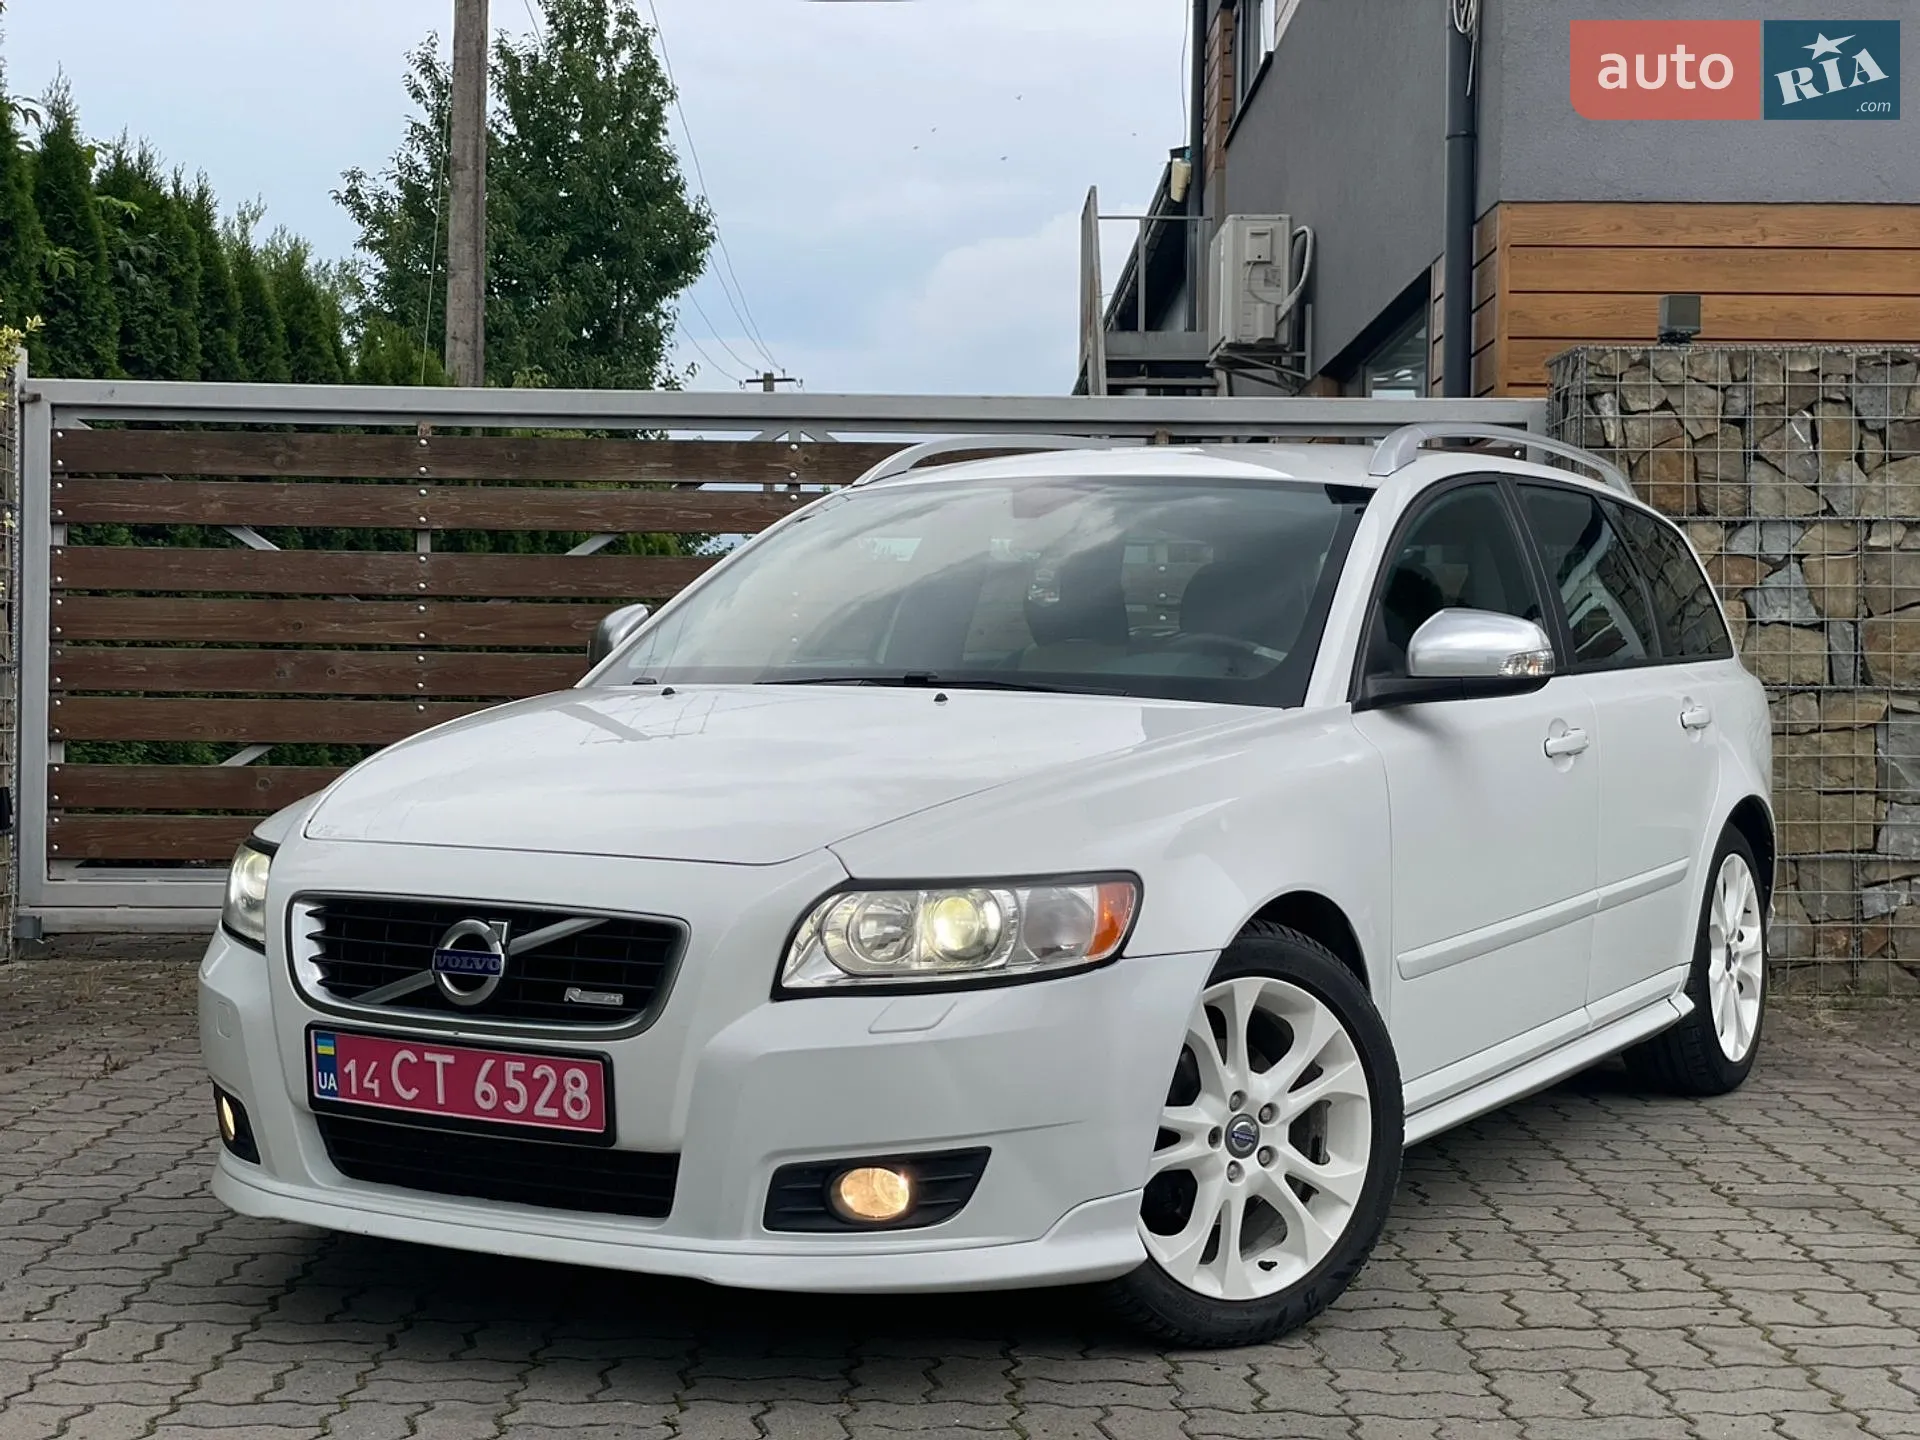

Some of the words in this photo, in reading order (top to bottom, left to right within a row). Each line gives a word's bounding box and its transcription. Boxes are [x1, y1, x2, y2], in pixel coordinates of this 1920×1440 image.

[435, 955, 500, 971] VOLVO
[318, 1072, 338, 1091] UA
[343, 1059, 380, 1098] 14
[391, 1050, 455, 1105] CT
[474, 1059, 591, 1121] 6528
